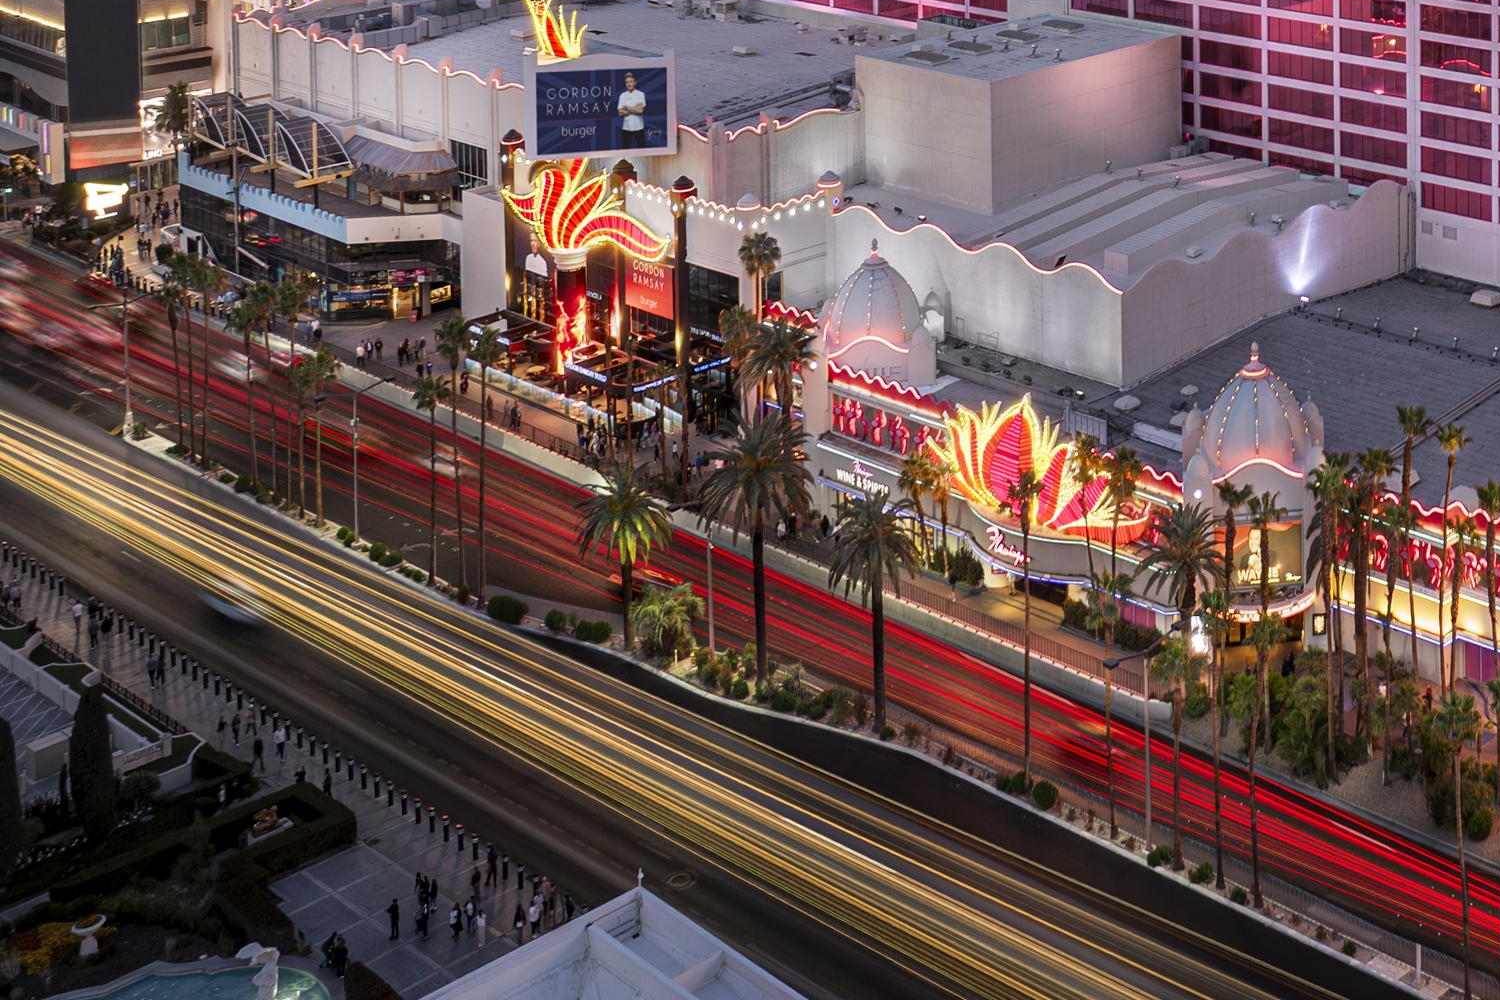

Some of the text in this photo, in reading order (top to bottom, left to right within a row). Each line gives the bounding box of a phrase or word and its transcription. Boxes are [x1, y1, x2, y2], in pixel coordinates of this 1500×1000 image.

[546, 85, 612, 100] GORDON
[546, 101, 611, 115] RAMSAY
[561, 126, 597, 138] burger
[632, 259, 665, 278] GORDON
[632, 272, 665, 291] RAMSAY
[640, 295, 658, 309] burger
[836, 468, 856, 486] WINE
[857, 475, 863, 489] &
